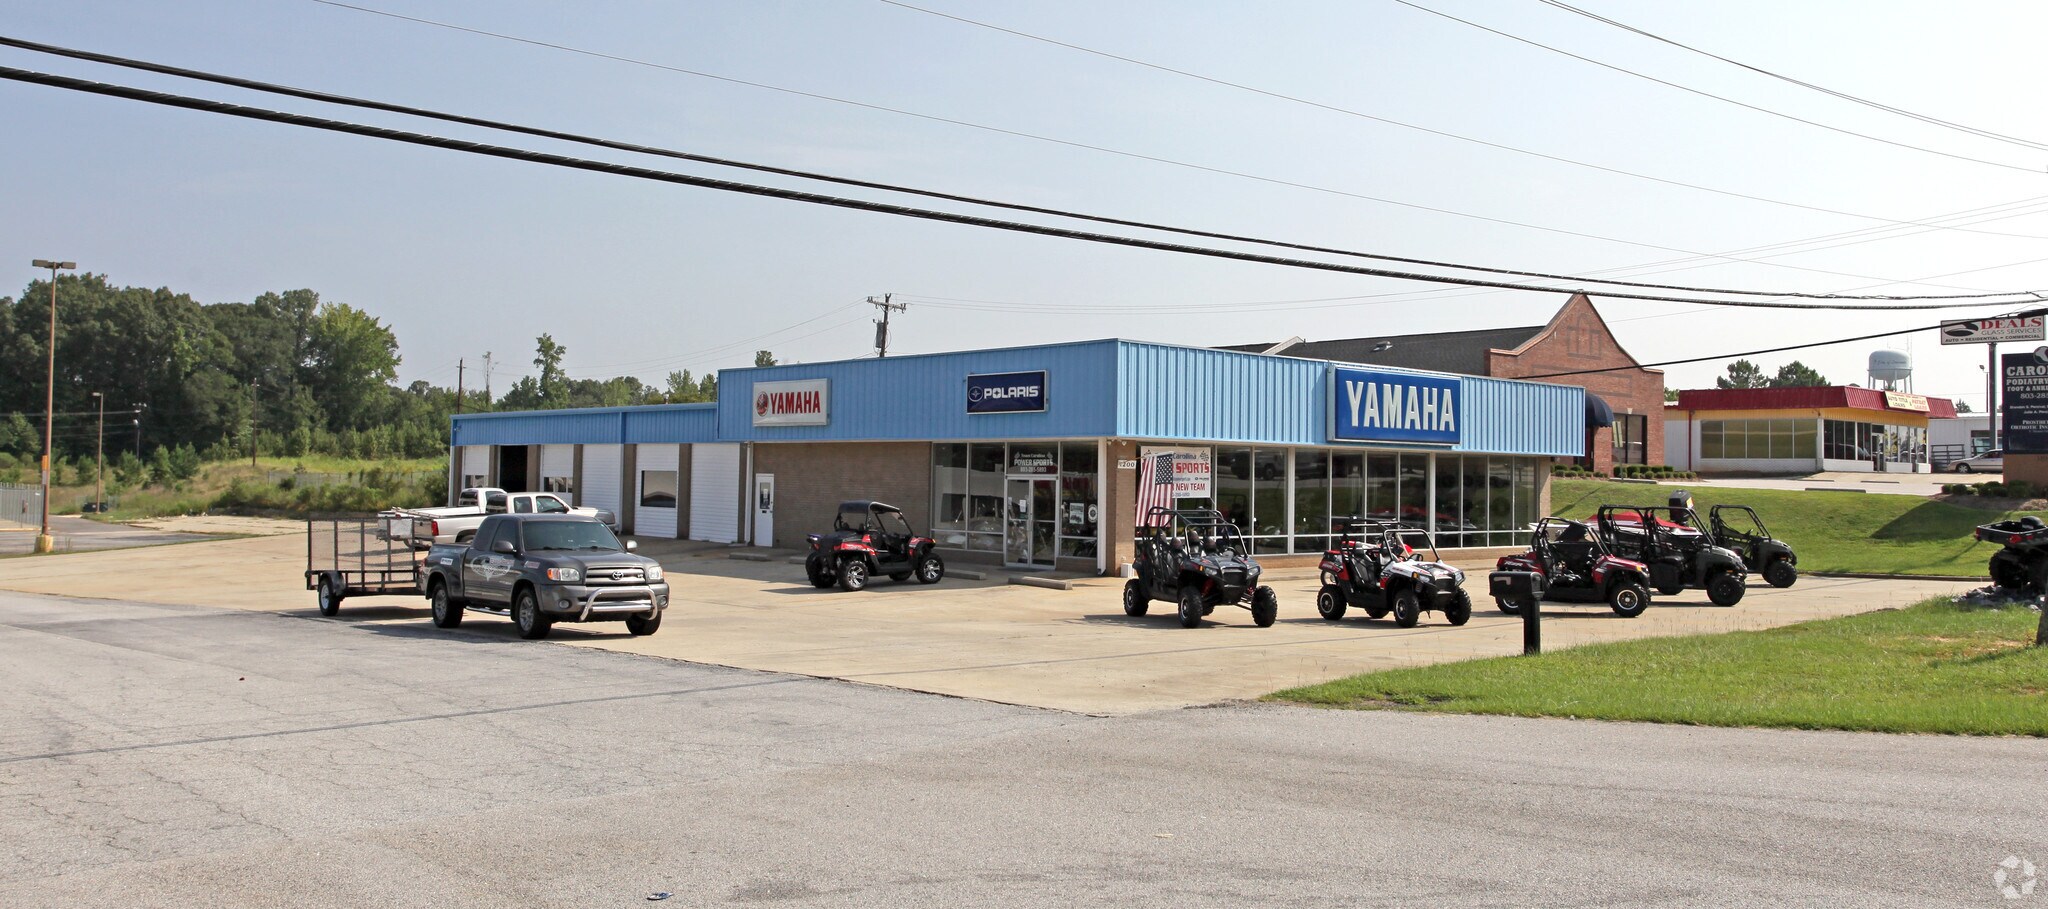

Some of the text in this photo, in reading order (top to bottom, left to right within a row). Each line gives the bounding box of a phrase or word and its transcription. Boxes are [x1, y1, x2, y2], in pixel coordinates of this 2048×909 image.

[1981, 317, 2042, 329] DEALS
[1981, 327, 2042, 336] GLASS SERVICES
[984, 386, 1039, 399] POLARIS
[770, 391, 821, 414] YAMAHA
[1346, 380, 1455, 432] YAMAHA
[1033, 458, 1053, 466] SPORTS
[1173, 452, 1197, 460] Carolina
[1176, 462, 1210, 474] SPORTS
[1176, 483, 1189, 491] NEW
